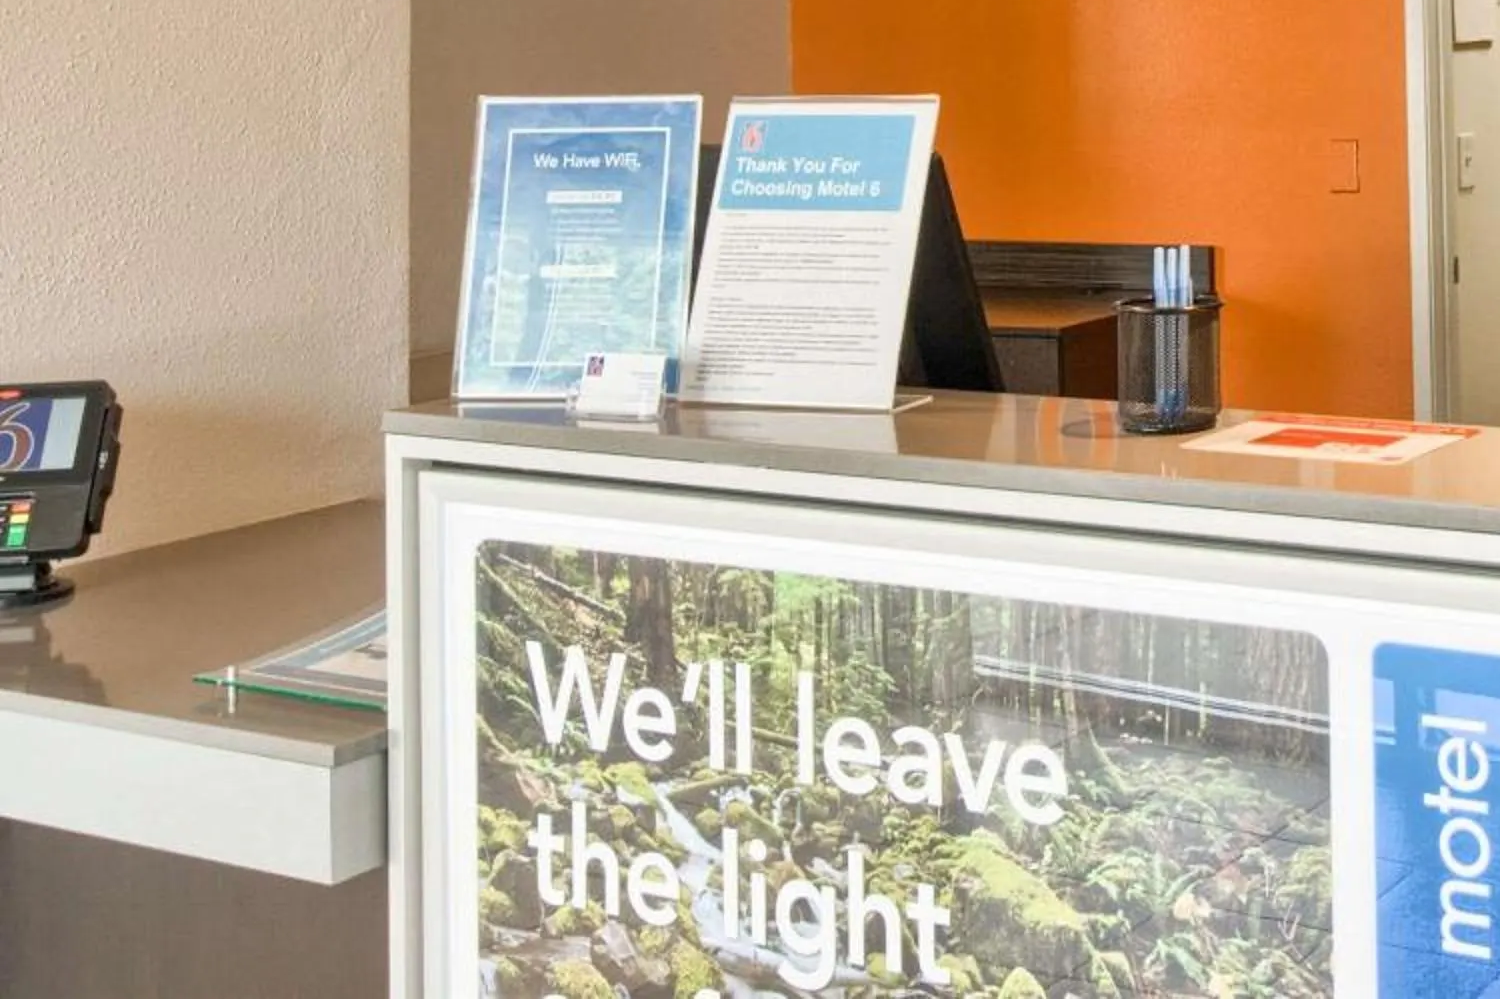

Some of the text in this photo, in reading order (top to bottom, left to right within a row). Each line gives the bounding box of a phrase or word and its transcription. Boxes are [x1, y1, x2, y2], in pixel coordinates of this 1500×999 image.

[533, 152, 559, 169] We
[563, 152, 601, 169] Have
[731, 178, 881, 200] Choosing Motel 6
[735, 156, 861, 175] Thank You For
[526, 639, 1068, 826] We'll leave
[1421, 713, 1493, 961] motel
[527, 800, 952, 991] the light
